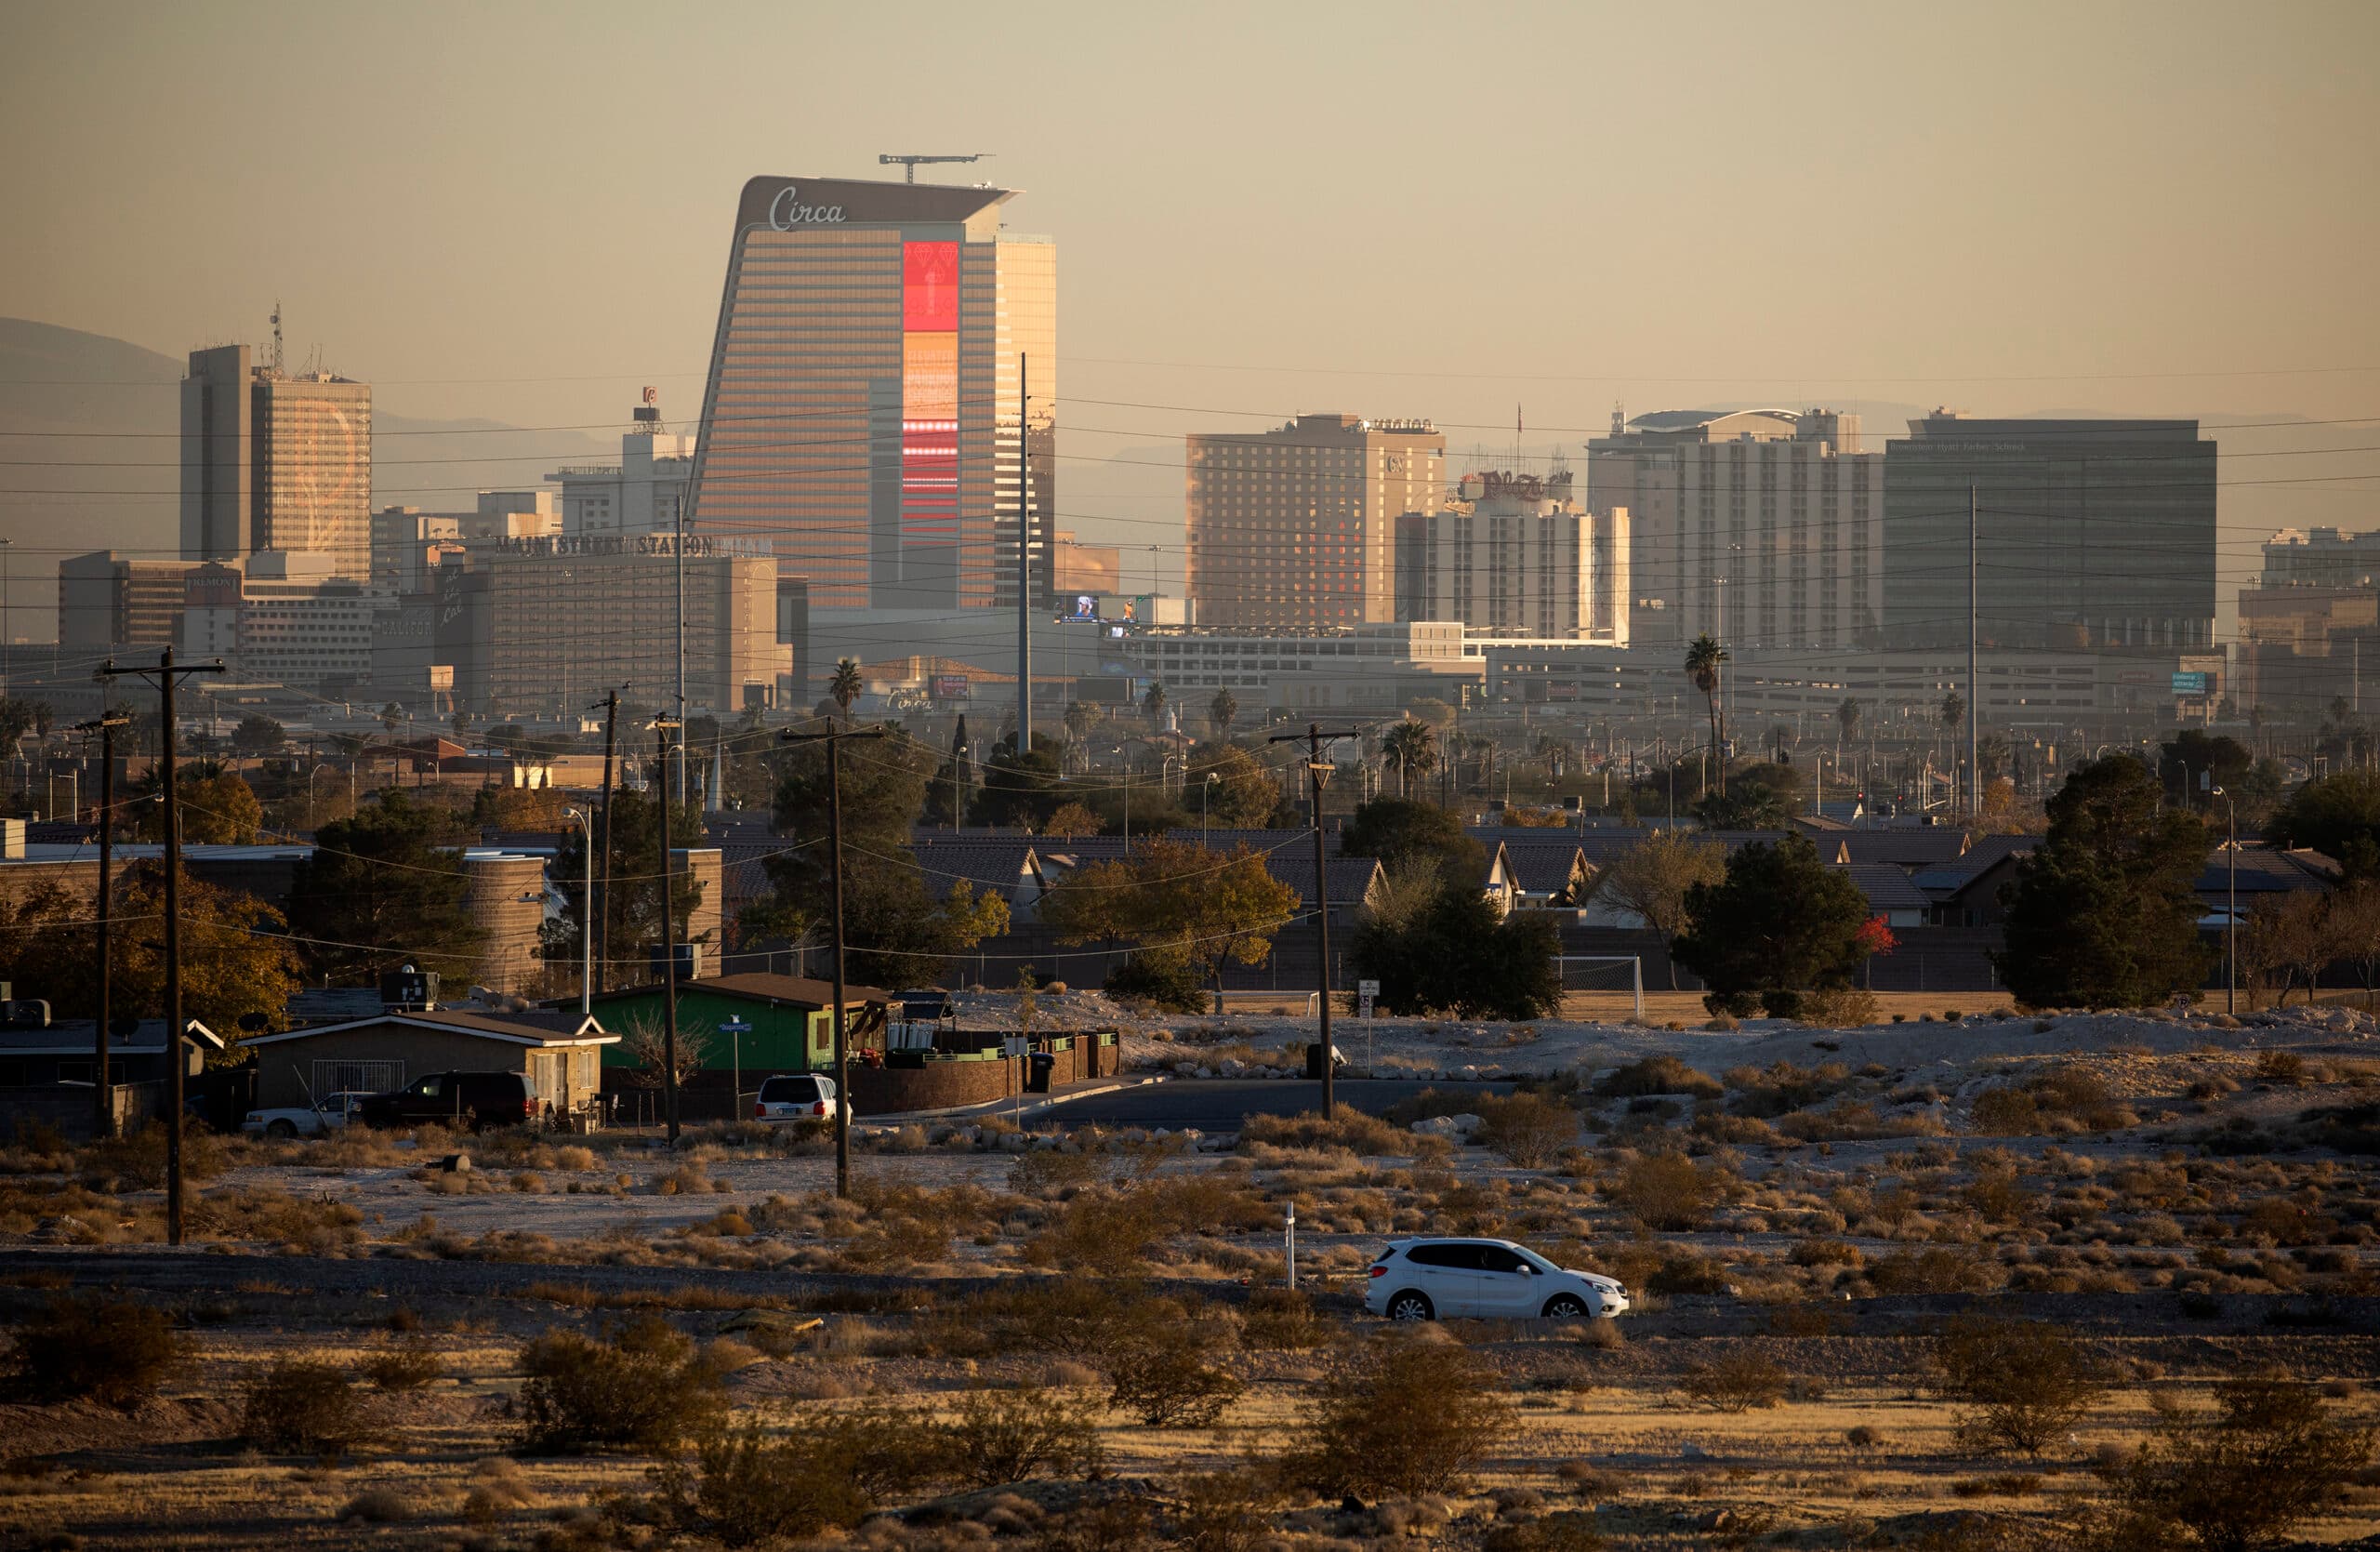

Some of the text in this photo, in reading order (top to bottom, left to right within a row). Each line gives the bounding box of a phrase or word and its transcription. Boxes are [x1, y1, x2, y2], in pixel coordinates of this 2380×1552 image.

[769, 185, 847, 232] Circa
[1890, 442, 1933, 451] Brownstein
[1478, 470, 1545, 502] Plaza
[496, 536, 546, 555] MAIN
[559, 536, 626, 555] STREET
[639, 537, 711, 555] STATION
[186, 577, 239, 593] FREMONT
[886, 690, 933, 710] Circa
